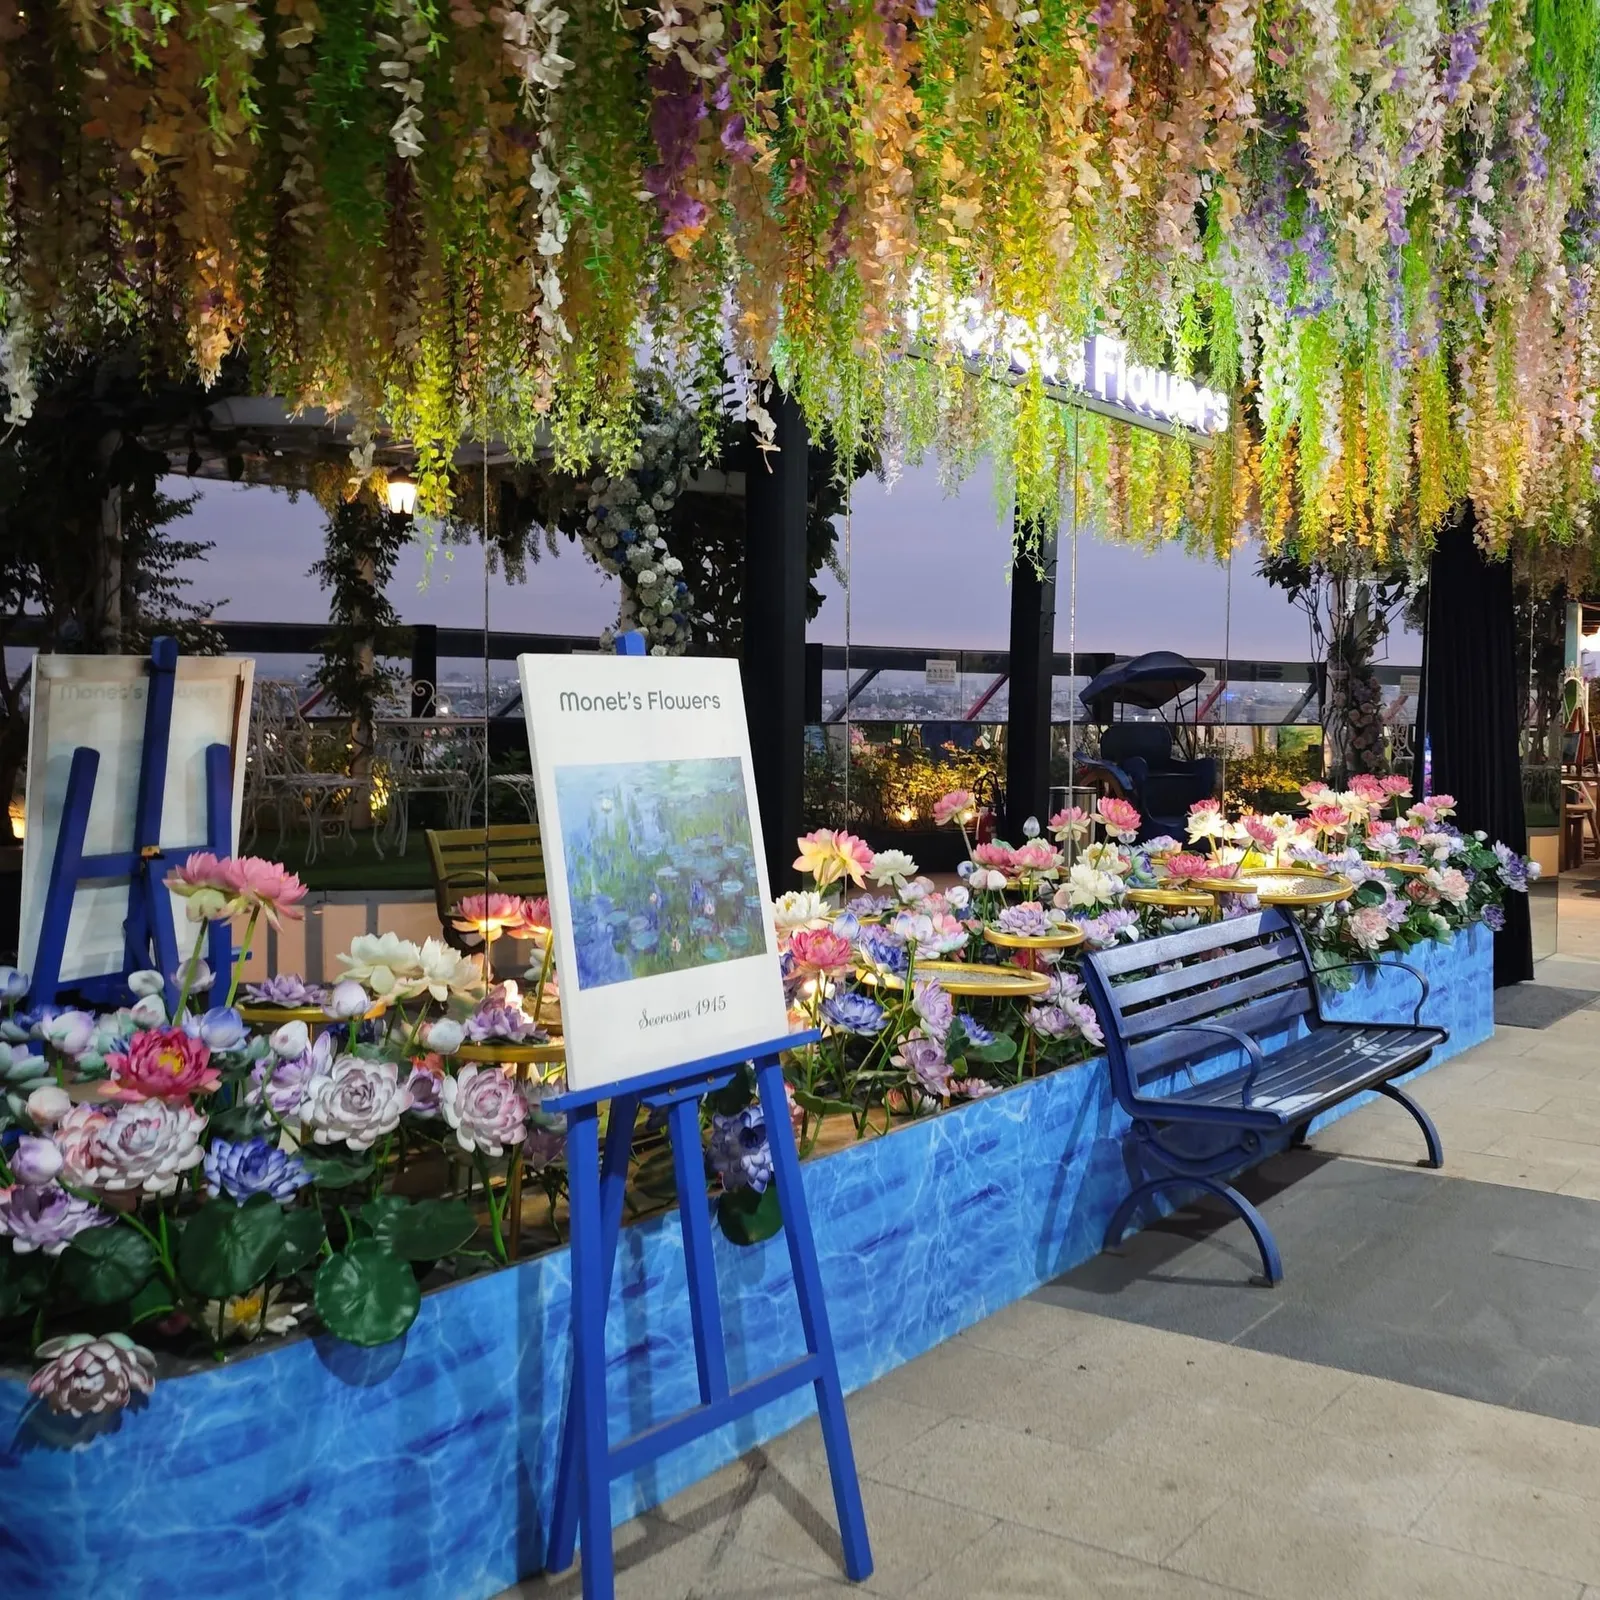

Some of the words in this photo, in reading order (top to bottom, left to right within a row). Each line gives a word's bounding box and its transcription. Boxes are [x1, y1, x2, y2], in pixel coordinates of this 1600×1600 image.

[559, 691, 642, 711] Monet's
[648, 690, 721, 710] Flowers
[638, 1008, 691, 1030] Seerosen
